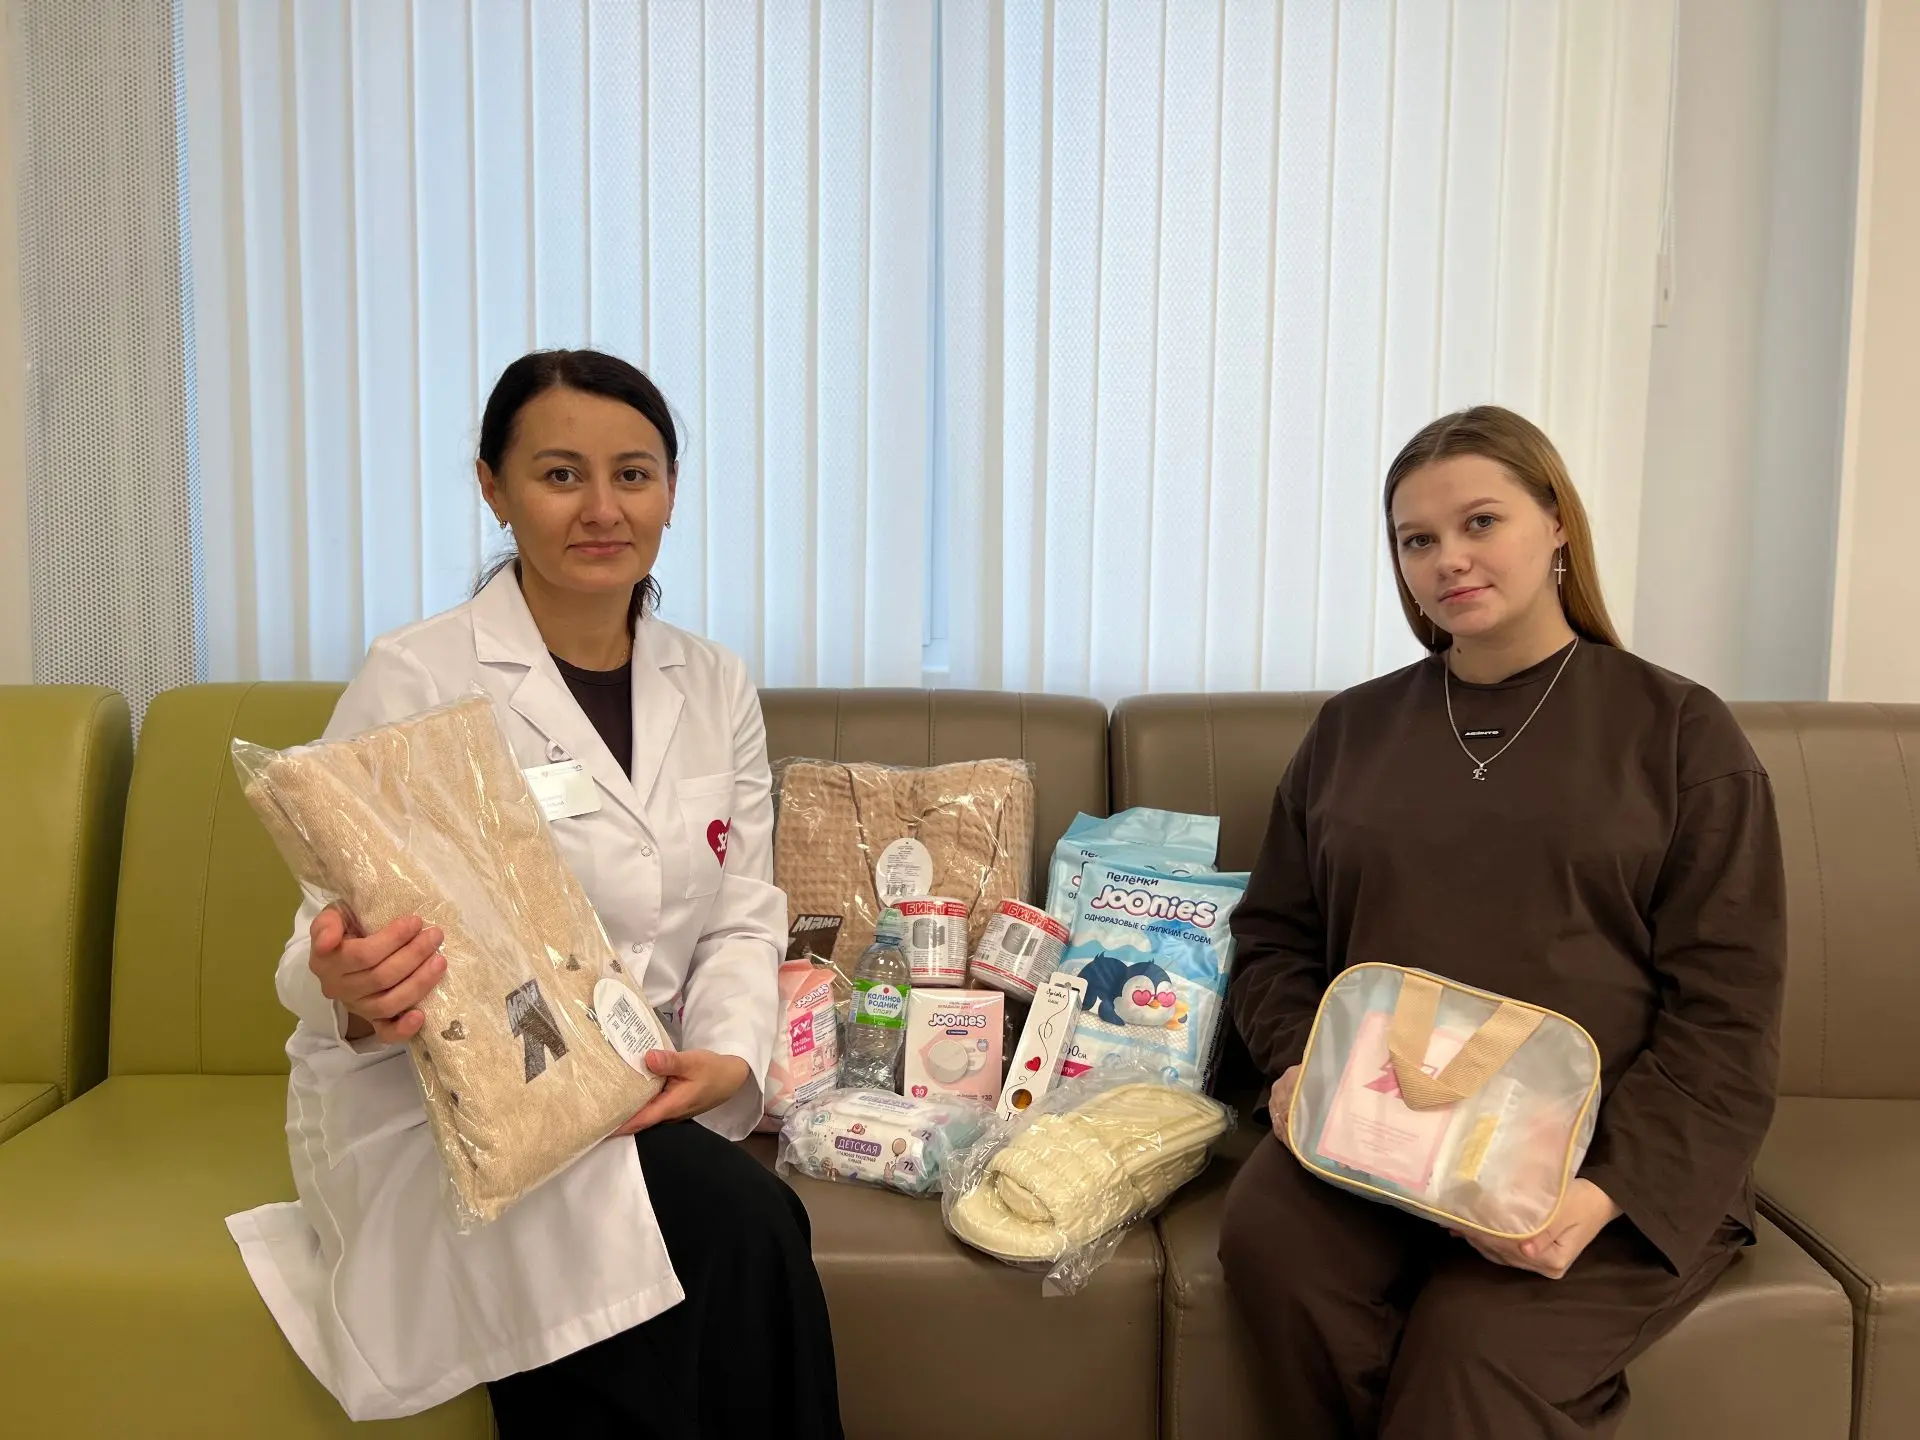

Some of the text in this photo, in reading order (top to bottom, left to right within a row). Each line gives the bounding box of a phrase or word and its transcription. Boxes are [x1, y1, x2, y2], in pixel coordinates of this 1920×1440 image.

[906, 902, 947, 915] БИНТ
[1007, 904, 1049, 929] БИНТ
[1084, 913, 1139, 930] ОДНОРАЗОВЫЕ
[1146, 925, 1181, 938] ЛИПКИМ
[1183, 931, 1212, 945] СЛОЕМ
[868, 999, 898, 1009] РОДНИК
[914, 1088, 925, 1096] 30
[920, 1129, 932, 1141] 72
[837, 1138, 878, 1156] ДЕТСКАЯ
[903, 1160, 914, 1171] 72
